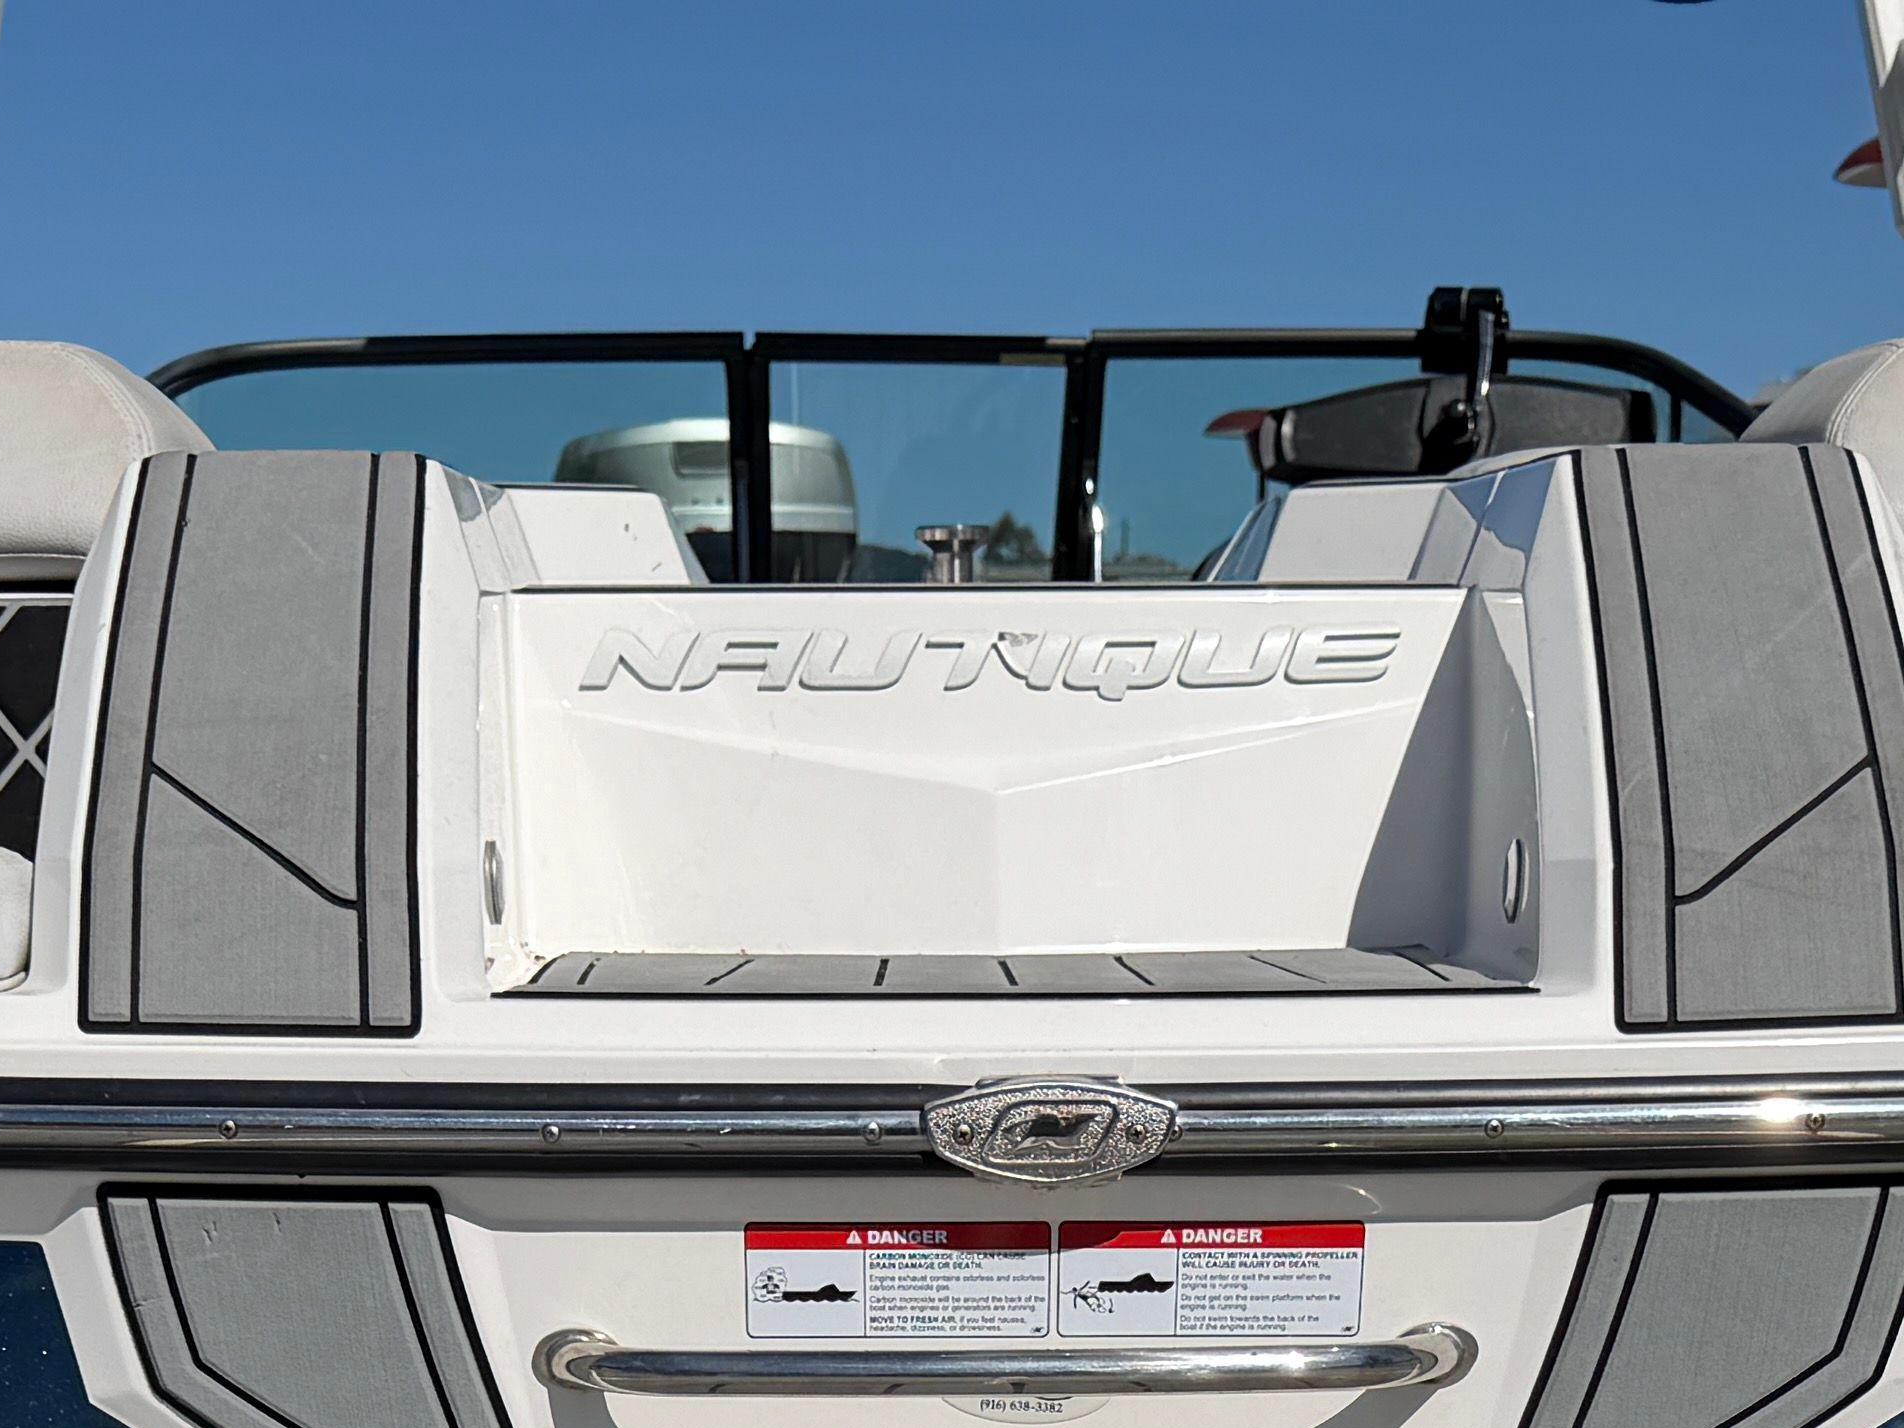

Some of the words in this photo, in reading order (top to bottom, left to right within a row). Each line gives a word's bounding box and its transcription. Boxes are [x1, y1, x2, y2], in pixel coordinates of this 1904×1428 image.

[578, 624, 1401, 702] NAUTIQUE
[867, 1230, 948, 1244] DANGER
[1182, 1229, 1263, 1244] DANGER
[896, 1315, 909, 1324] TO
[979, 1398, 1006, 1412] (916)
[1009, 1399, 1064, 1413] 638-3382
